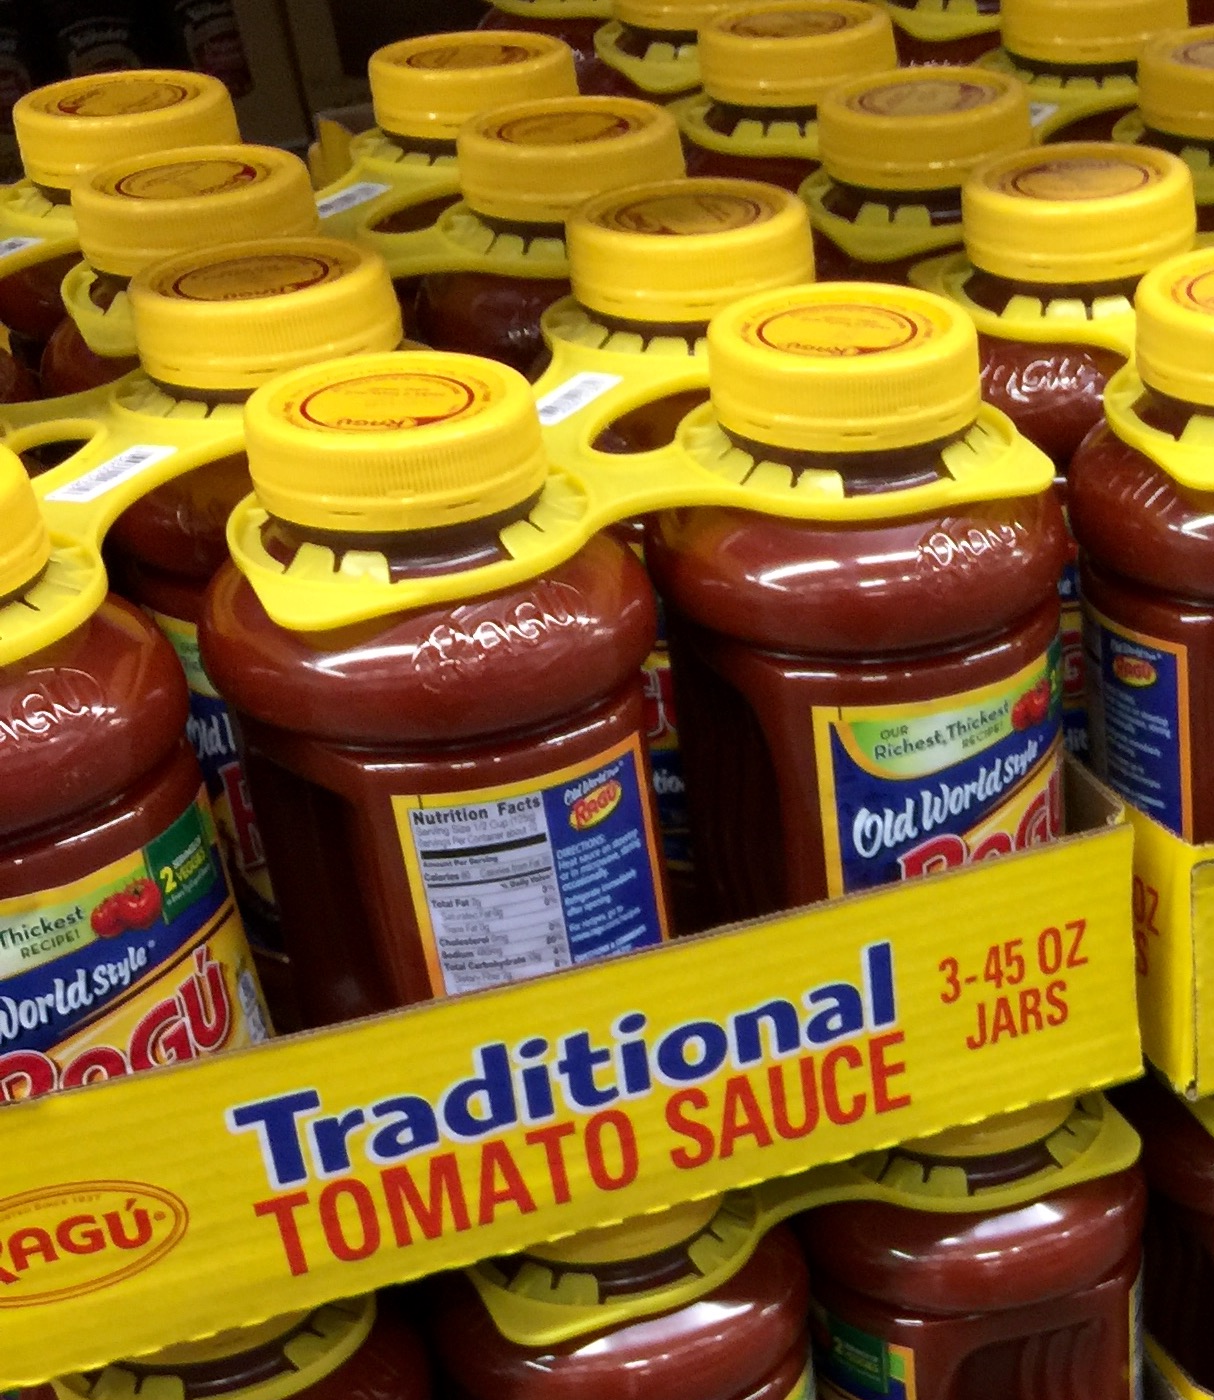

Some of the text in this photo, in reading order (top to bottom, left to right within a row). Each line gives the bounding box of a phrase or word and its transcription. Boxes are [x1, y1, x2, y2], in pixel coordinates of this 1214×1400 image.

[874, 700, 1009, 760] Richest, Thickest
[880, 725, 909, 741] OUR
[412, 796, 540, 825] Nutrition Facts
[853, 798, 917, 859] Old
[921, 758, 1002, 831] World
[160, 866, 177, 893] 2
[0, 906, 84, 950] Thickest
[20, 929, 80, 960] RECIPE!
[93, 946, 147, 997] Style
[938, 936, 1025, 1005] 3-45
[1038, 919, 1089, 974] OZ
[965, 980, 1070, 1051] JARS
[234, 942, 896, 1187] Traditional
[254, 1031, 912, 1277] TOMATO SAUCE
